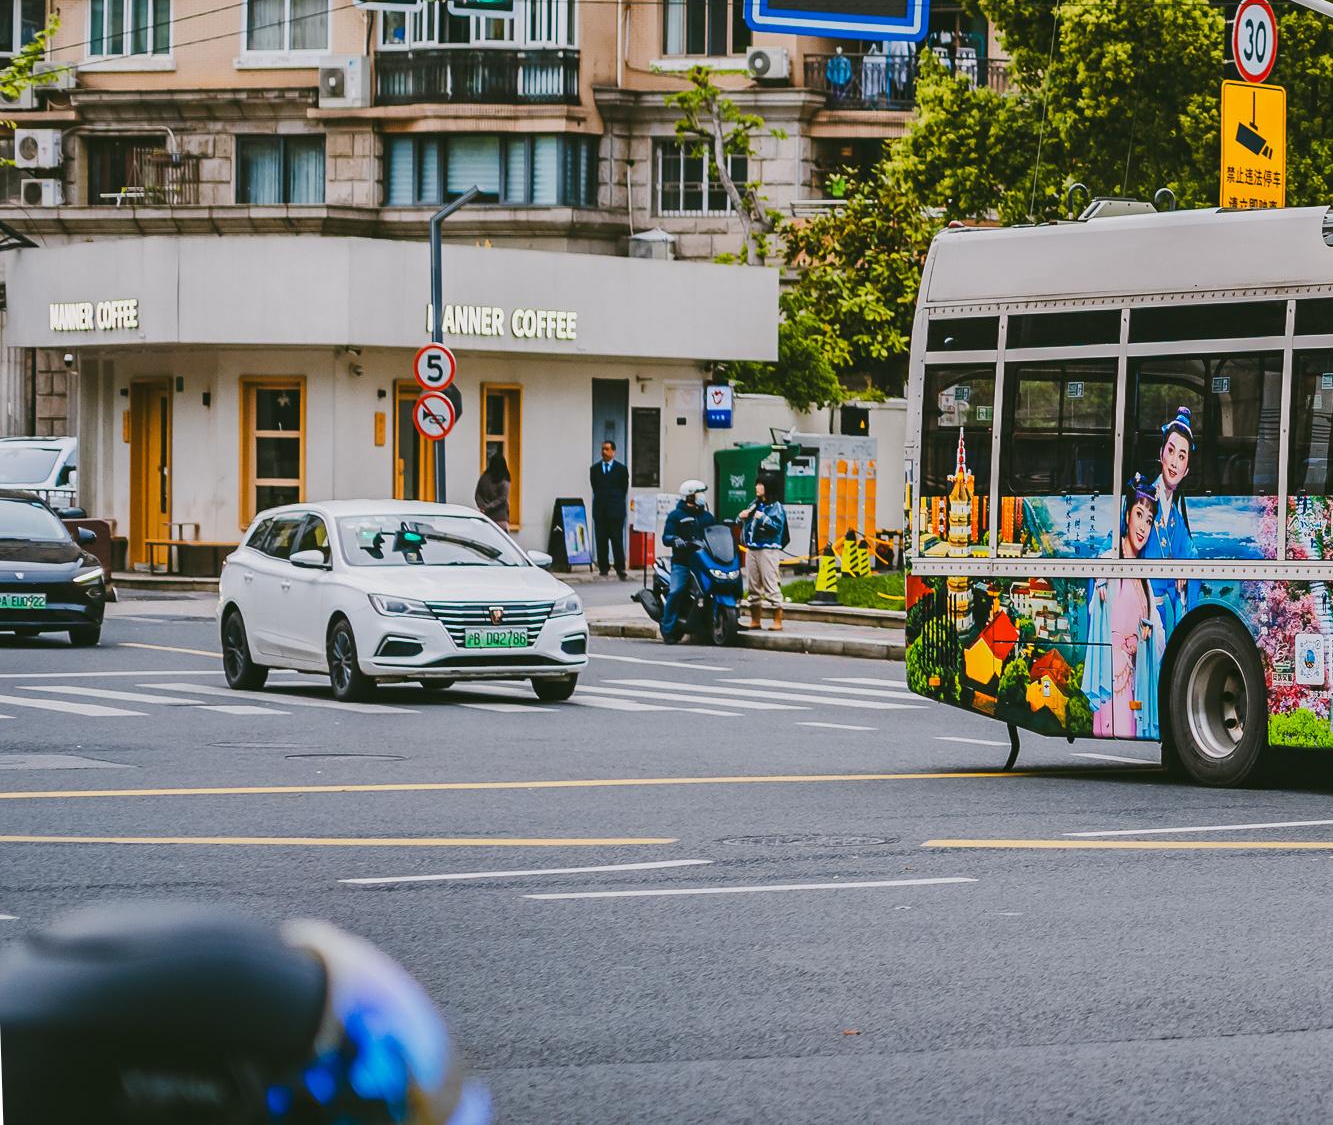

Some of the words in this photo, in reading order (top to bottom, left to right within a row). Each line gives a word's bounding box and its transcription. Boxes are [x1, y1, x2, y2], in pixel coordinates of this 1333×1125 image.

[1243, 18, 1267, 64] 30
[1226, 166, 1281, 188] 禁止违法停车
[49, 302, 95, 331] MANNER
[96, 299, 139, 330] COFFEE
[427, 304, 505, 337] ANNER
[511, 308, 578, 340] COFFEE
[427, 355, 443, 382] 5
[0, 596, 8, 607] A
[11, 595, 45, 607] EU0922
[486, 631, 527, 646] DQ2786
